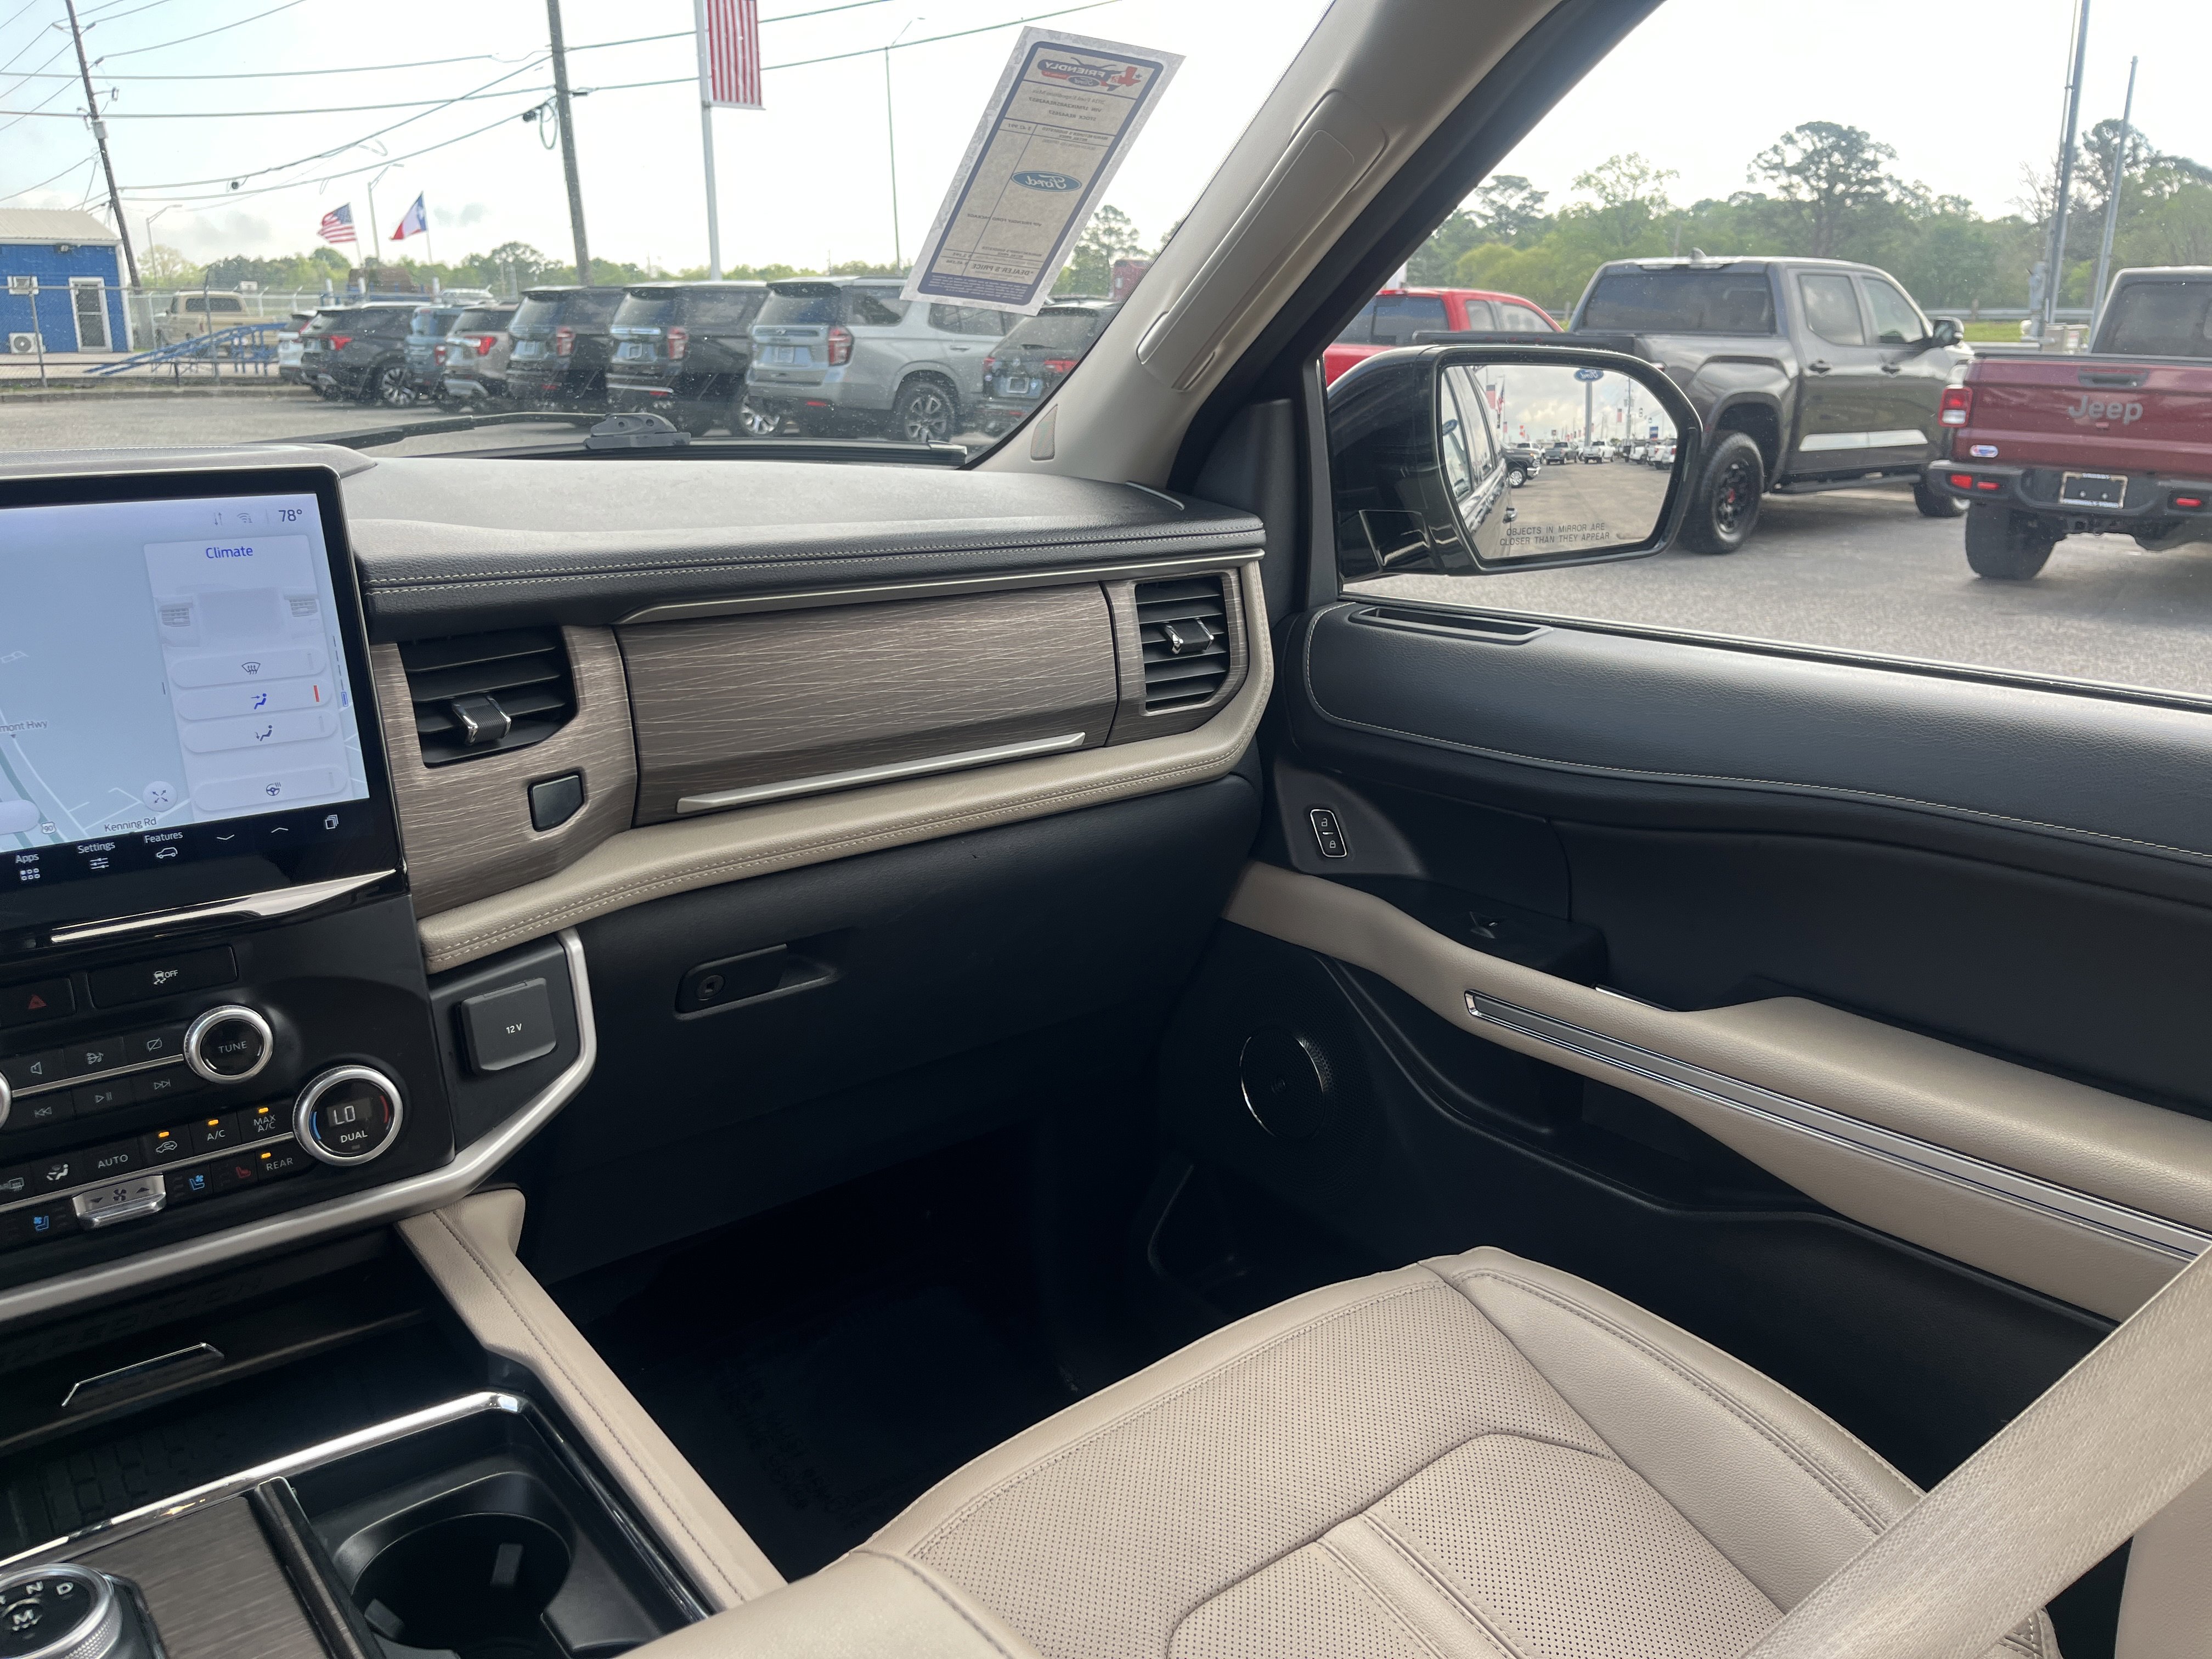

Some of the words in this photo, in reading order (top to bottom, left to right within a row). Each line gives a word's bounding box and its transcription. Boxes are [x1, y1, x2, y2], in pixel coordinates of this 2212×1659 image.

[2068, 395, 2143, 425] Jeep
[278, 509, 302, 522] 78°
[1506, 527, 1542, 535] OBJECTS
[1558, 524, 1587, 533] MIRROR
[1500, 537, 1530, 546] CLOSER
[1535, 535, 1555, 544] THAN
[1559, 534, 1578, 543] THEY
[1581, 532, 1610, 540] APPEAR
[206, 546, 253, 558] Climate
[26, 720, 48, 729] Hwy
[104, 819, 143, 832] Kenning
[144, 817, 157, 826] Rd
[144, 831, 183, 844] Features
[77, 841, 116, 854] Settings
[15, 853, 40, 864] Apps
[165, 969, 178, 978] OFF
[218, 1041, 247, 1054] TUNE
[254, 1114, 276, 1126] MAX
[257, 1120, 276, 1132] A/C
[207, 1130, 226, 1141] A/C
[340, 1130, 368, 1143] DUAL
[98, 1154, 128, 1169] AUTO
[266, 1157, 294, 1171] REAR
[26, 1581, 44, 1595] N
[56, 1582, 74, 1595] D
[13, 1609, 34, 1625] M
